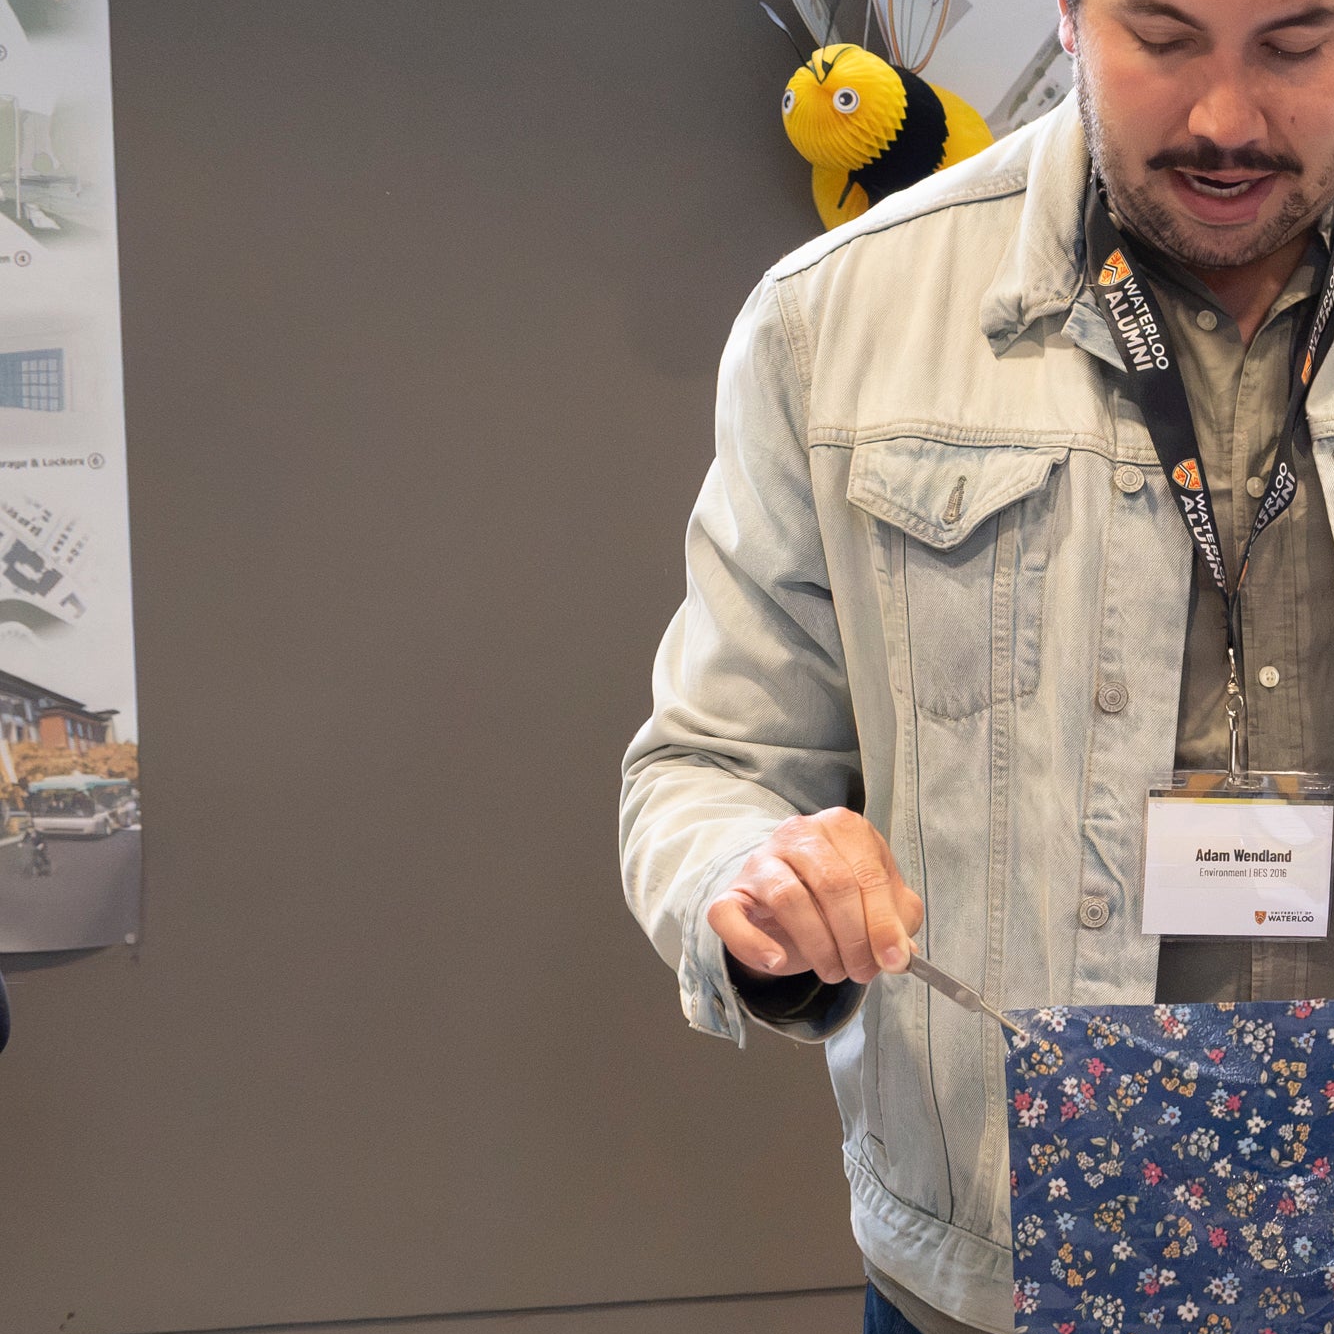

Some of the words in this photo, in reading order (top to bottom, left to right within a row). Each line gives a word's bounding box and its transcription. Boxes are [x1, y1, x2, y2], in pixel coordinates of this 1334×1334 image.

[1104, 290, 1154, 372] ALUMNI
[1123, 277, 1169, 370] WATERLOO
[1180, 495, 1224, 587] ALUMNI
[1195, 848, 1230, 863] Adam
[1234, 848, 1292, 863] Wendland
[1199, 867, 1247, 878] Environment
[1253, 868, 1268, 878] BES
[1270, 868, 1287, 878] 2016
[1268, 915, 1314, 923] WATERLOO
